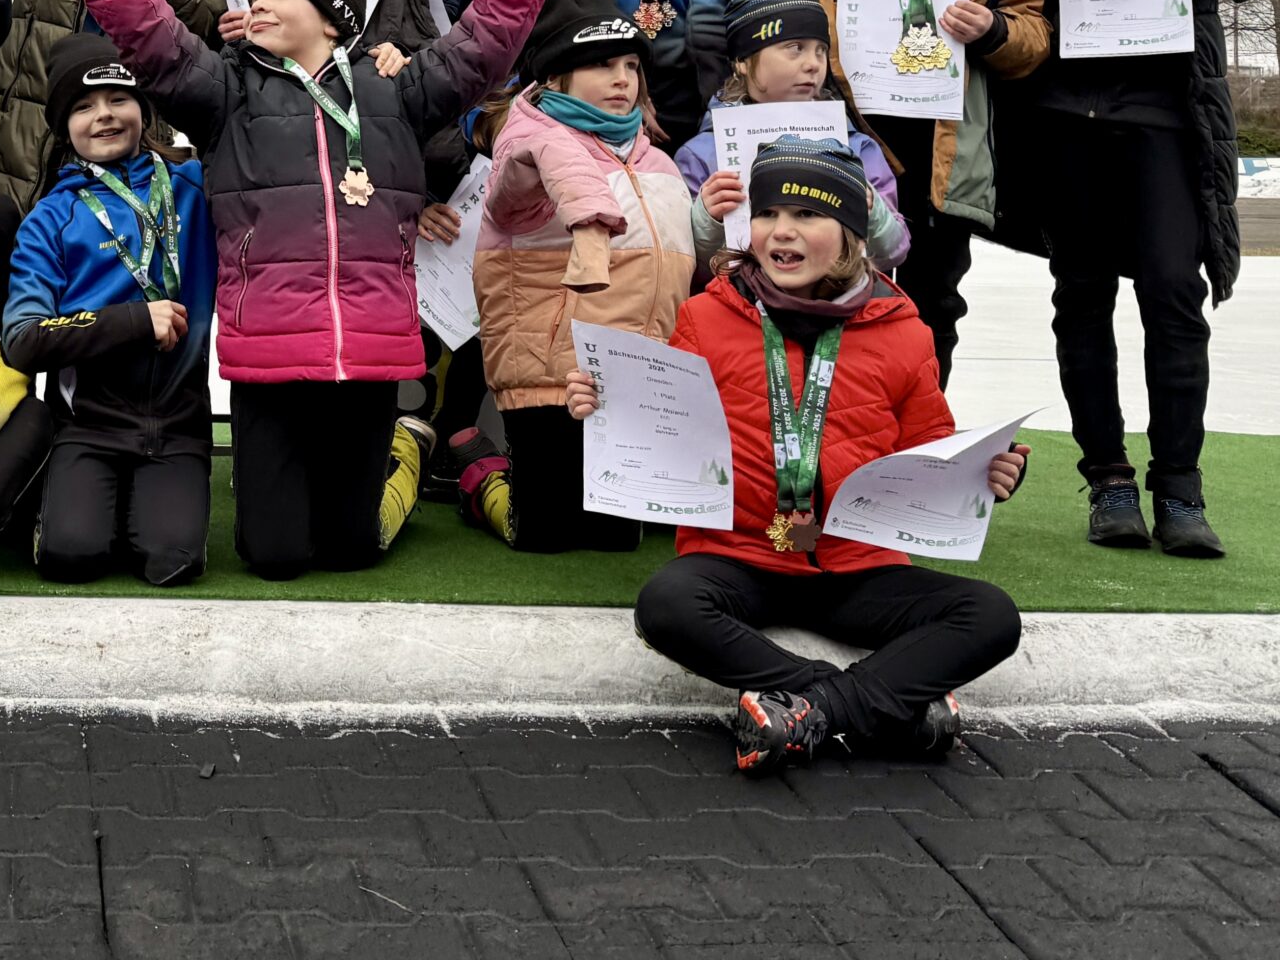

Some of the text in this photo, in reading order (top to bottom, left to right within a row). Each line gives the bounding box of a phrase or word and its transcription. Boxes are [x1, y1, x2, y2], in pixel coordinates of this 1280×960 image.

[746, 124, 835, 136] Sächsische Meisterschaft
[781, 181, 843, 209] Chemnitz
[607, 349, 652, 363] Sächsische
[816, 389, 827, 407] 2026
[779, 388, 789, 406] 2025
[784, 412, 793, 431] 2026
[812, 413, 822, 432] 2025
[645, 500, 730, 515] Dresden
[895, 529, 981, 548] Dresden
